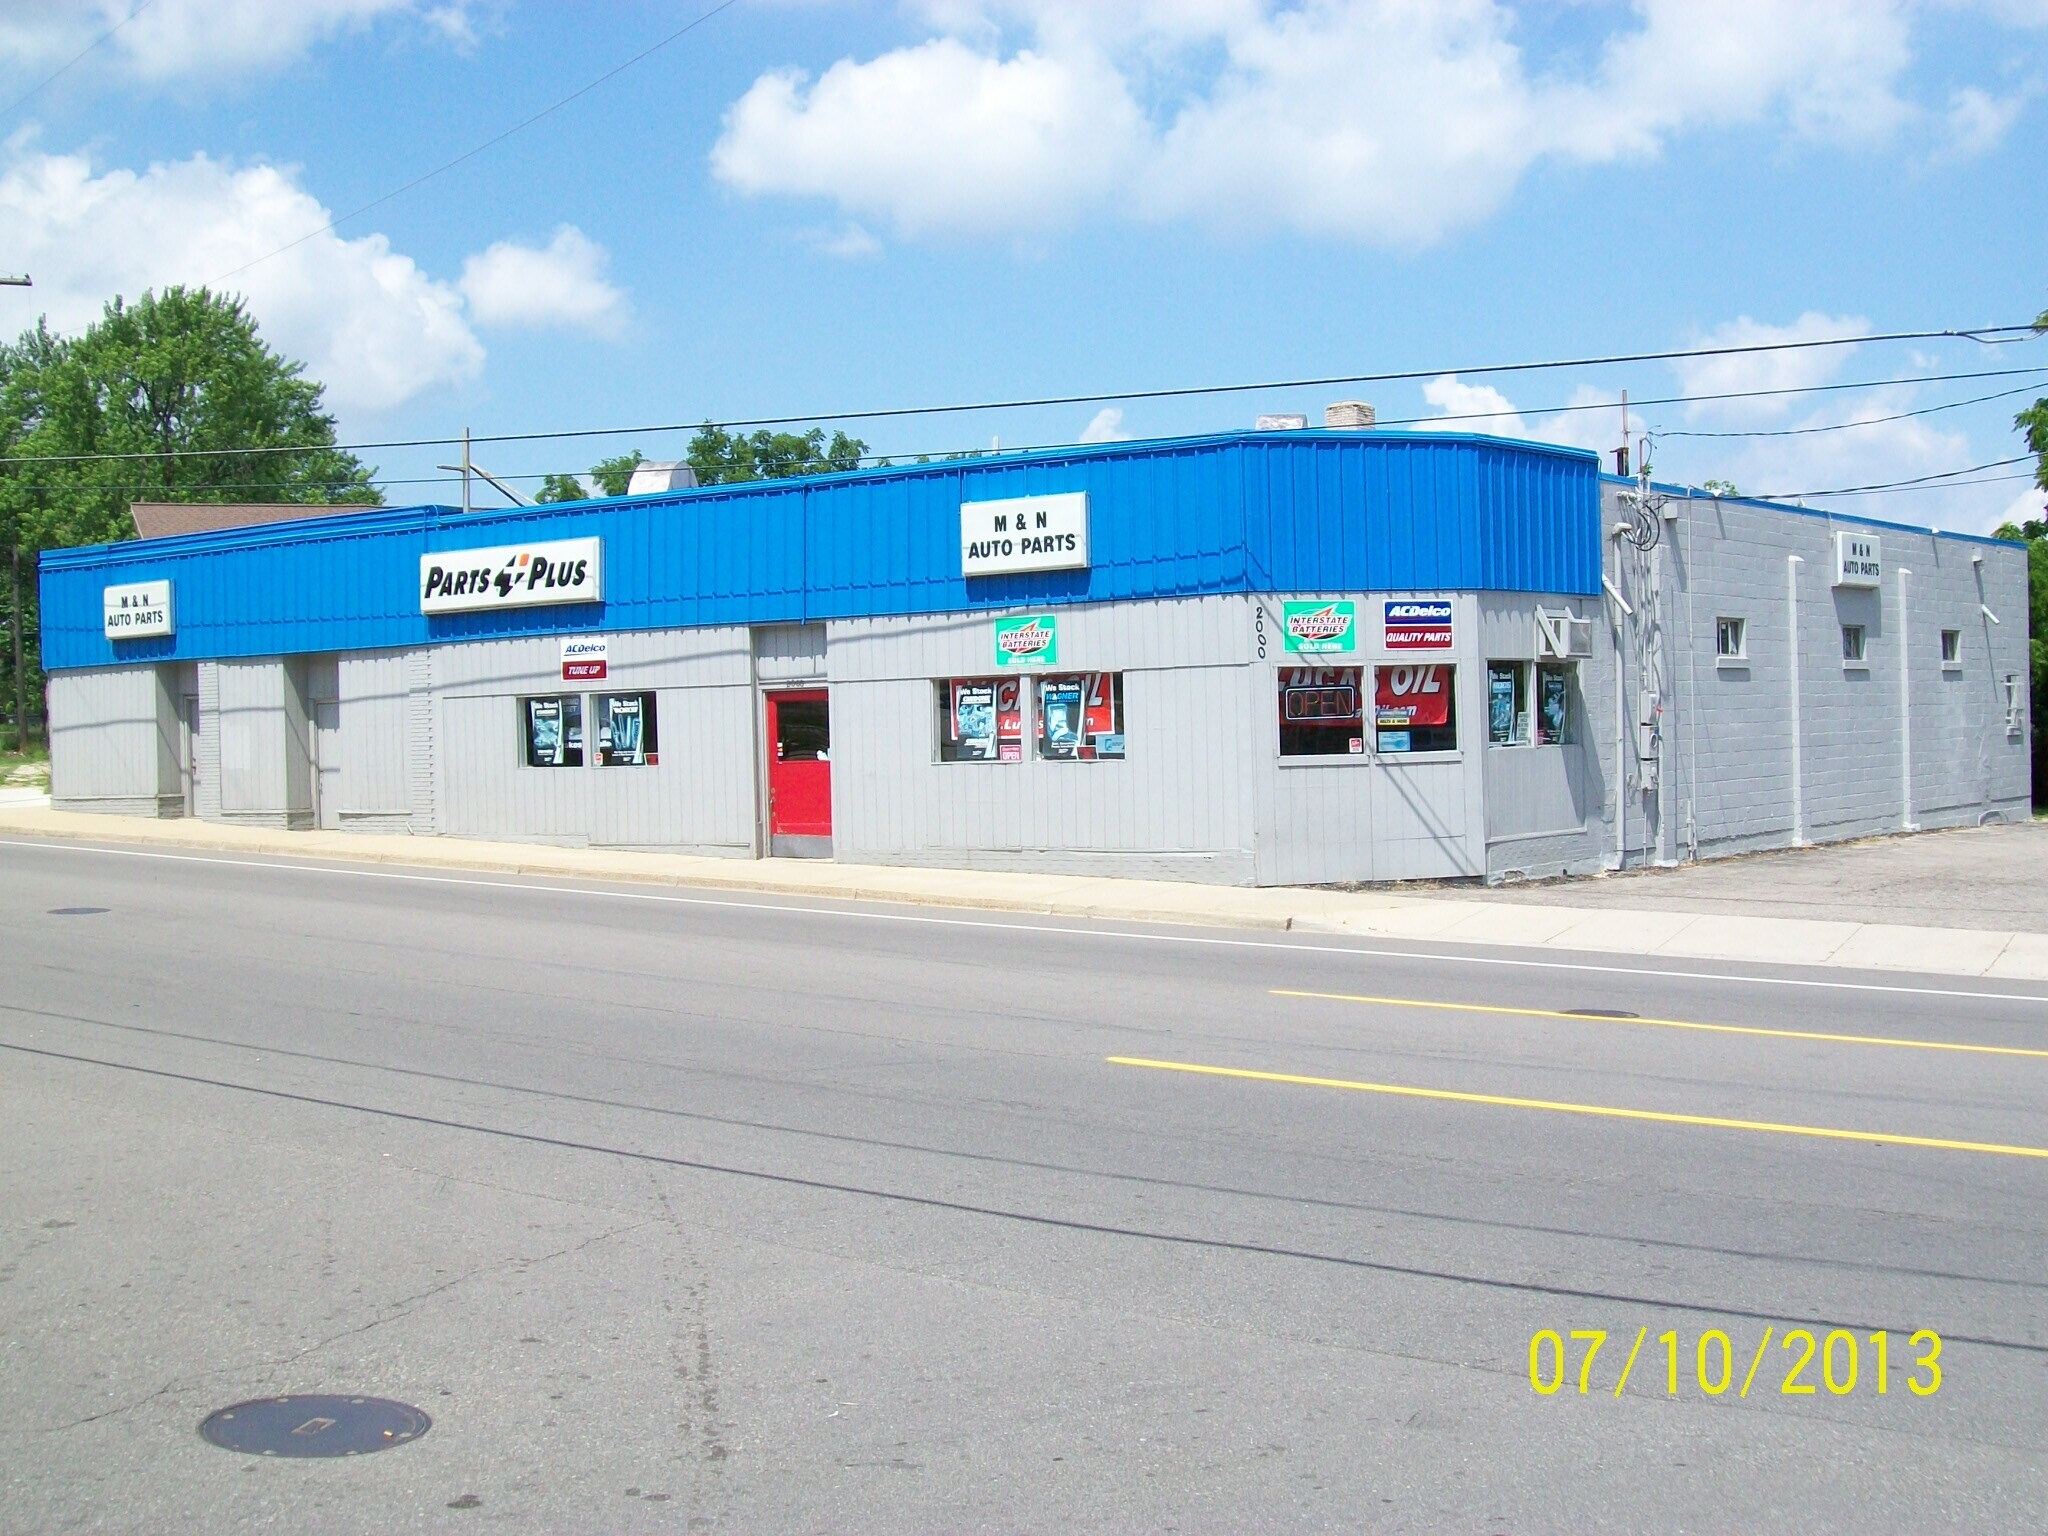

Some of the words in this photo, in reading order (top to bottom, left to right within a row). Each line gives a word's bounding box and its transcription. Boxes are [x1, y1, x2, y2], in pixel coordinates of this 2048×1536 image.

[994, 515, 1007, 532] M
[1016, 513, 1027, 530] &
[1036, 511, 1047, 528] N
[968, 539, 1013, 559] AUTO
[1021, 533, 1076, 555] PARTS
[1852, 543, 1857, 555] M
[1859, 544, 1863, 556] &
[1866, 544, 1870, 557] N
[1844, 561, 1858, 574] AUTO
[1860, 562, 1879, 576] PARTS
[424, 566, 492, 599] PARTS
[527, 556, 588, 591] PLUS
[121, 596, 129, 608] M
[132, 595, 138, 607] &
[143, 594, 149, 607] N
[1388, 605, 1451, 617] ACDelco
[107, 613, 132, 627] AUTO
[135, 610, 163, 625] PARTS
[1290, 616, 1349, 624] INTERSTATE
[1255, 606, 1267, 659] 2000
[1291, 625, 1344, 633] BATTERIES
[1000, 631, 1050, 640] INTERSTATE
[1386, 632, 1424, 642] QUALITY
[1423, 632, 1452, 642] PARTS
[565, 644, 606, 653] ACDelco
[1002, 639, 1047, 648] BATTERIES
[1298, 642, 1319, 650] SOLD
[568, 665, 589, 675] TUNE
[588, 665, 601, 674] UP
[1390, 664, 1441, 696] OIL
[1044, 684, 1057, 692] We
[1058, 683, 1080, 691] Stock
[1045, 692, 1079, 700] WAGNER
[1288, 690, 1352, 716] OPEN
